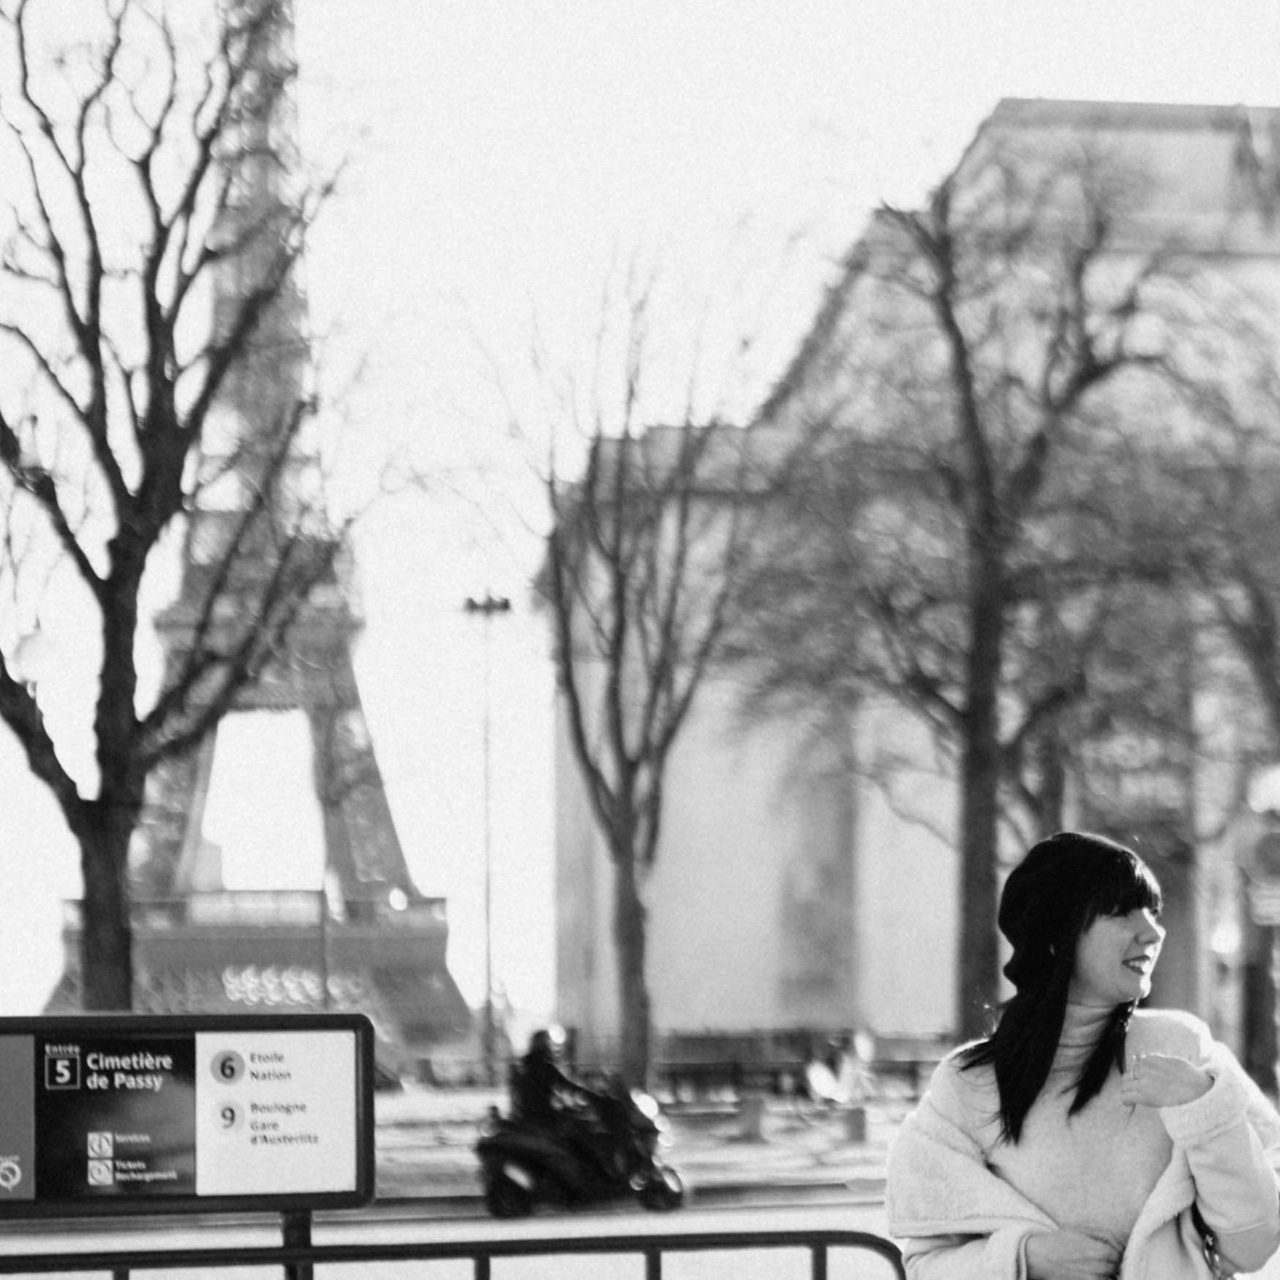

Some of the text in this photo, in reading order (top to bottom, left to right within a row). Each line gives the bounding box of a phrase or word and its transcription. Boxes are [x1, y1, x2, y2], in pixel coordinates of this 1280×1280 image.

[86, 1052, 173, 1070] Cimetière
[221, 1057, 235, 1079] 6
[55, 1059, 71, 1083] 5
[250, 1071, 291, 1080] Nation
[86, 1072, 163, 1092] de Passy
[221, 1107, 235, 1129] 9
[250, 1103, 306, 1114] Boulogne
[250, 1121, 279, 1131] Gare
